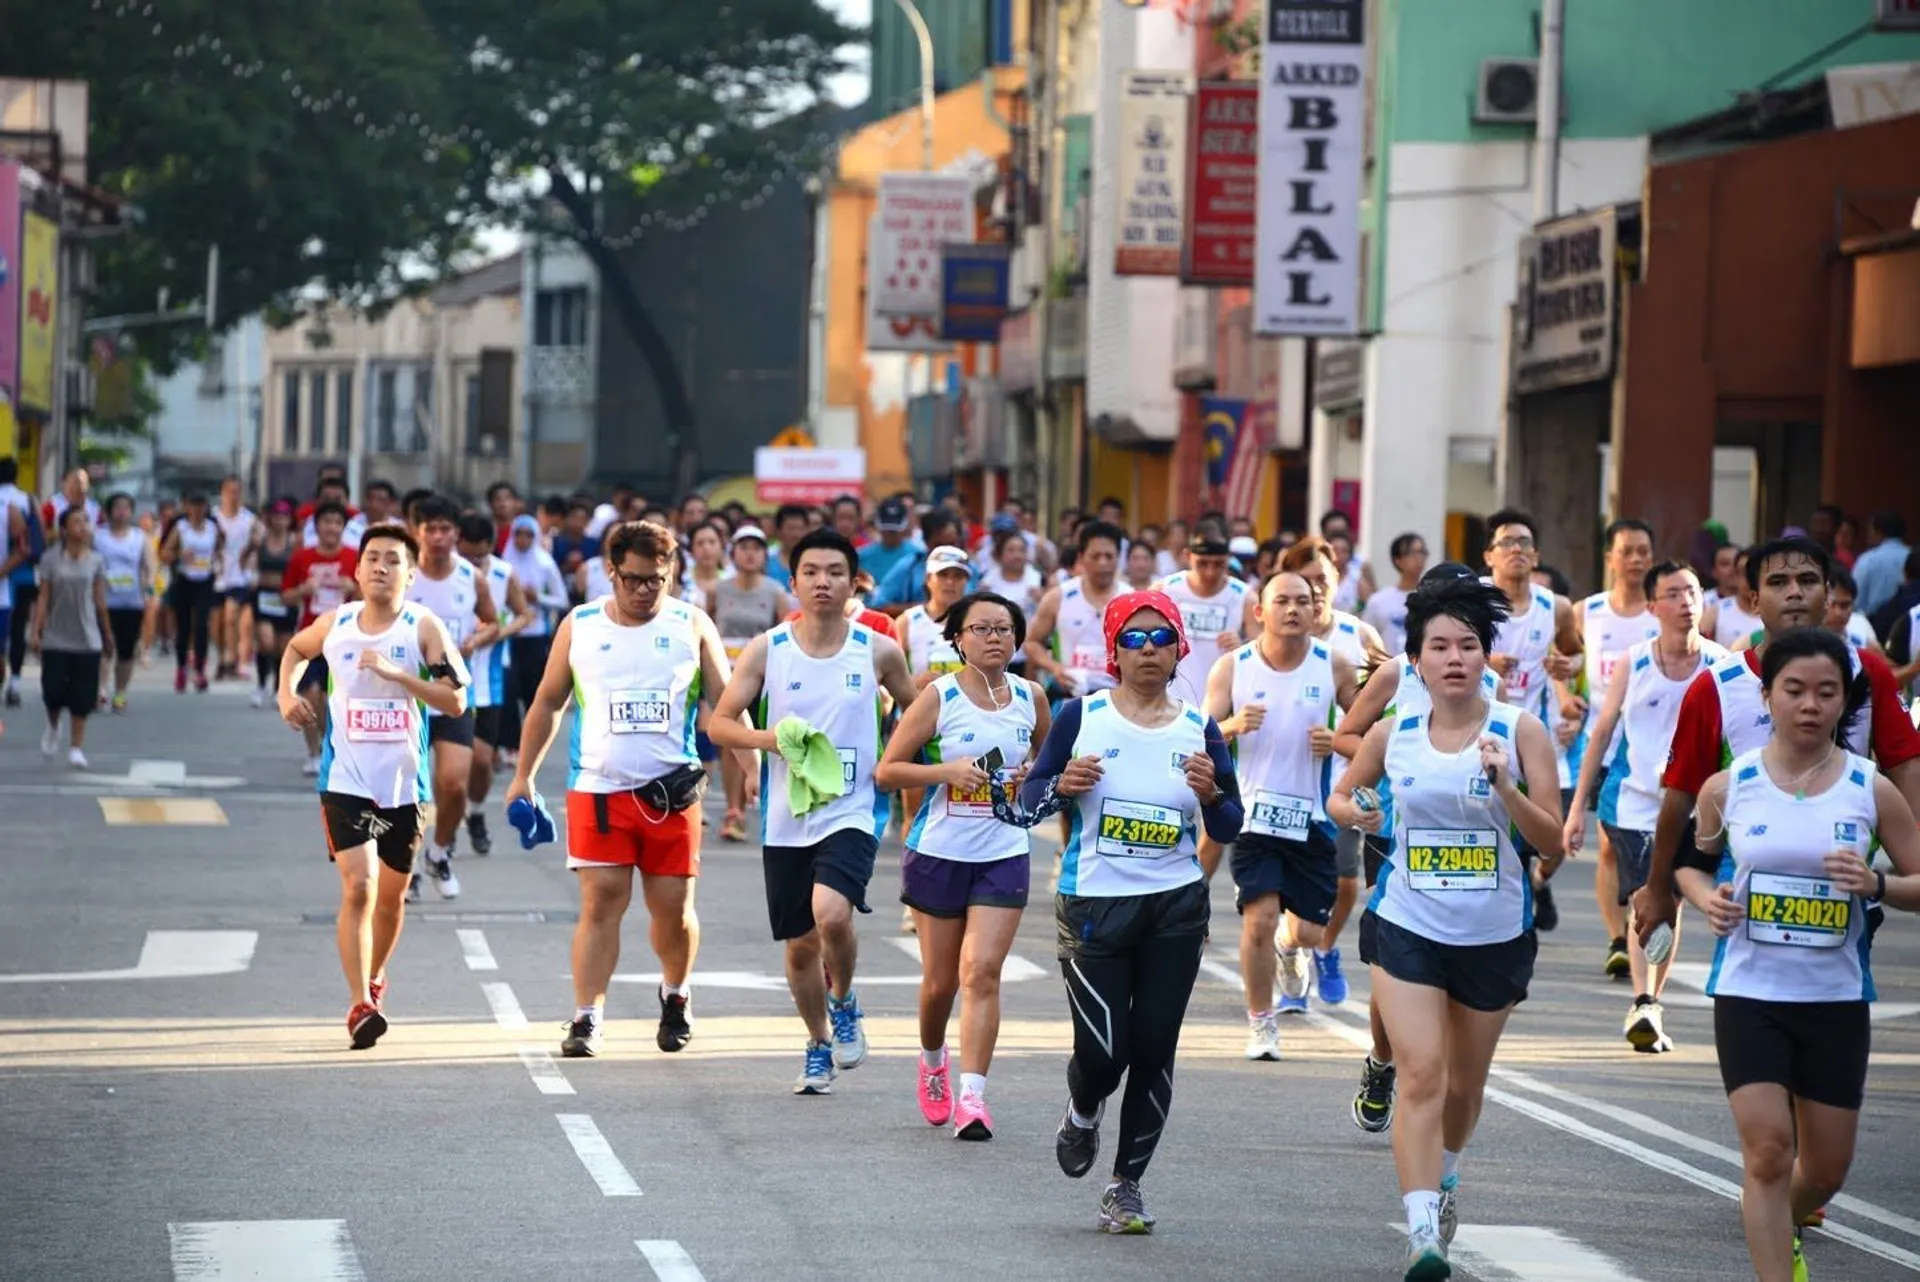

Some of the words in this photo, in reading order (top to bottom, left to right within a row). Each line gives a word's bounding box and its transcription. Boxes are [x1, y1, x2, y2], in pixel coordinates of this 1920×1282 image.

[1272, 63, 1361, 87] ARKED
[1279, 95, 1341, 307] BILAL
[1103, 816, 1179, 844] P2-31232
[1409, 847, 1496, 871] N2-29405
[1750, 894, 1848, 928] N2-29020
